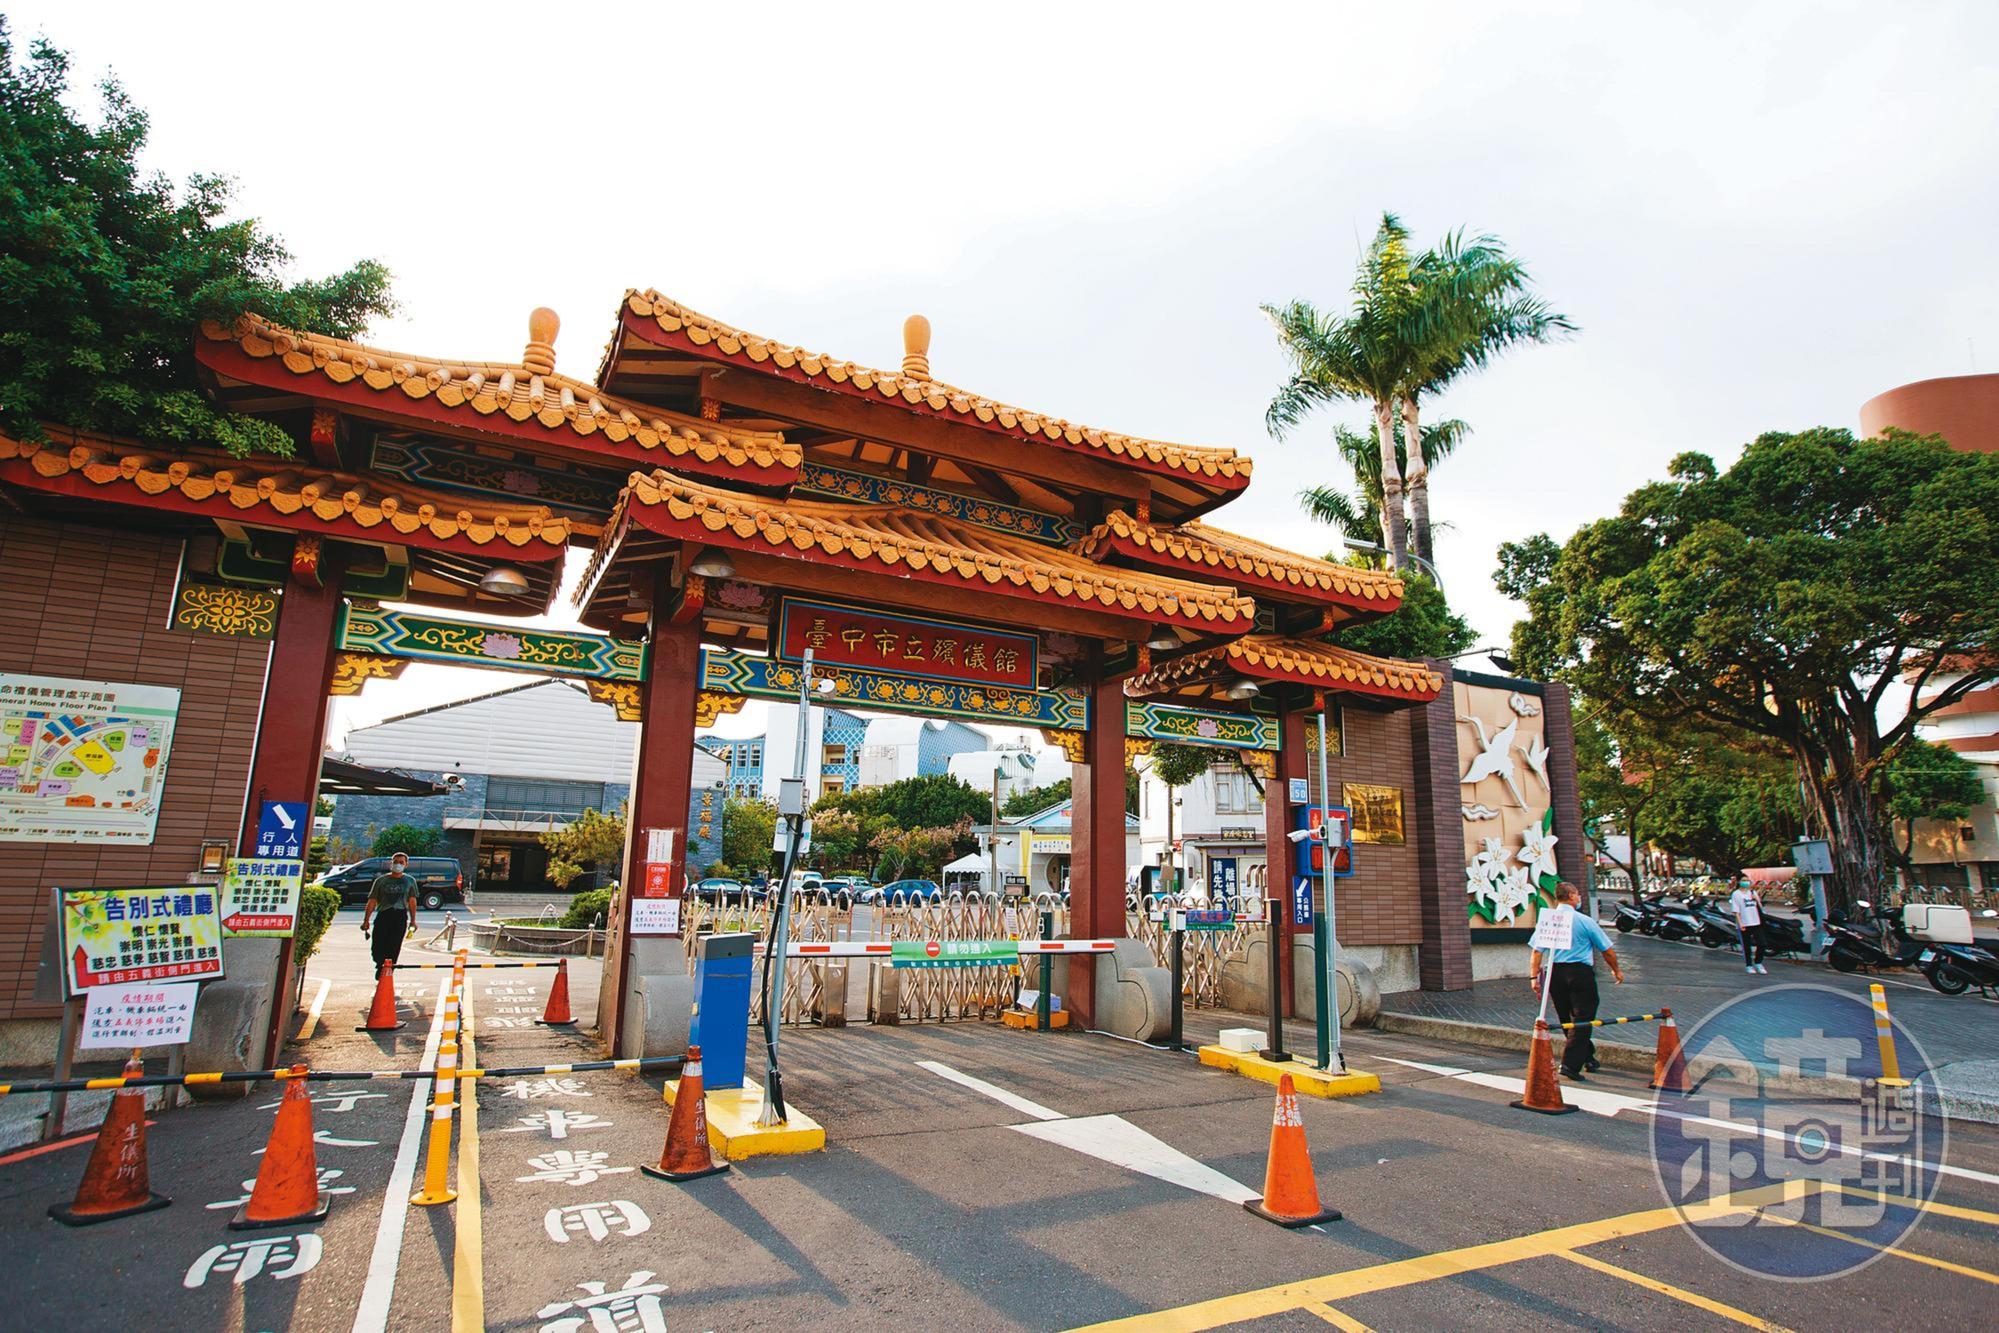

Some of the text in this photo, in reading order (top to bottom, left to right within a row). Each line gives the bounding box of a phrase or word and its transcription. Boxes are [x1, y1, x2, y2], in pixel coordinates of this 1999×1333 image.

[806, 619, 1019, 674] 臺中市立殯儀館
[29, 700, 56, 708] Home
[59, 702, 85, 710] Floor
[88, 704, 108, 712] Plan
[257, 845, 299, 857] 專用道
[237, 862, 301, 877] 告別式禮廳
[105, 894, 214, 921] 告別式禮廳
[98, 961, 216, 984] 請由五義街側門進入
